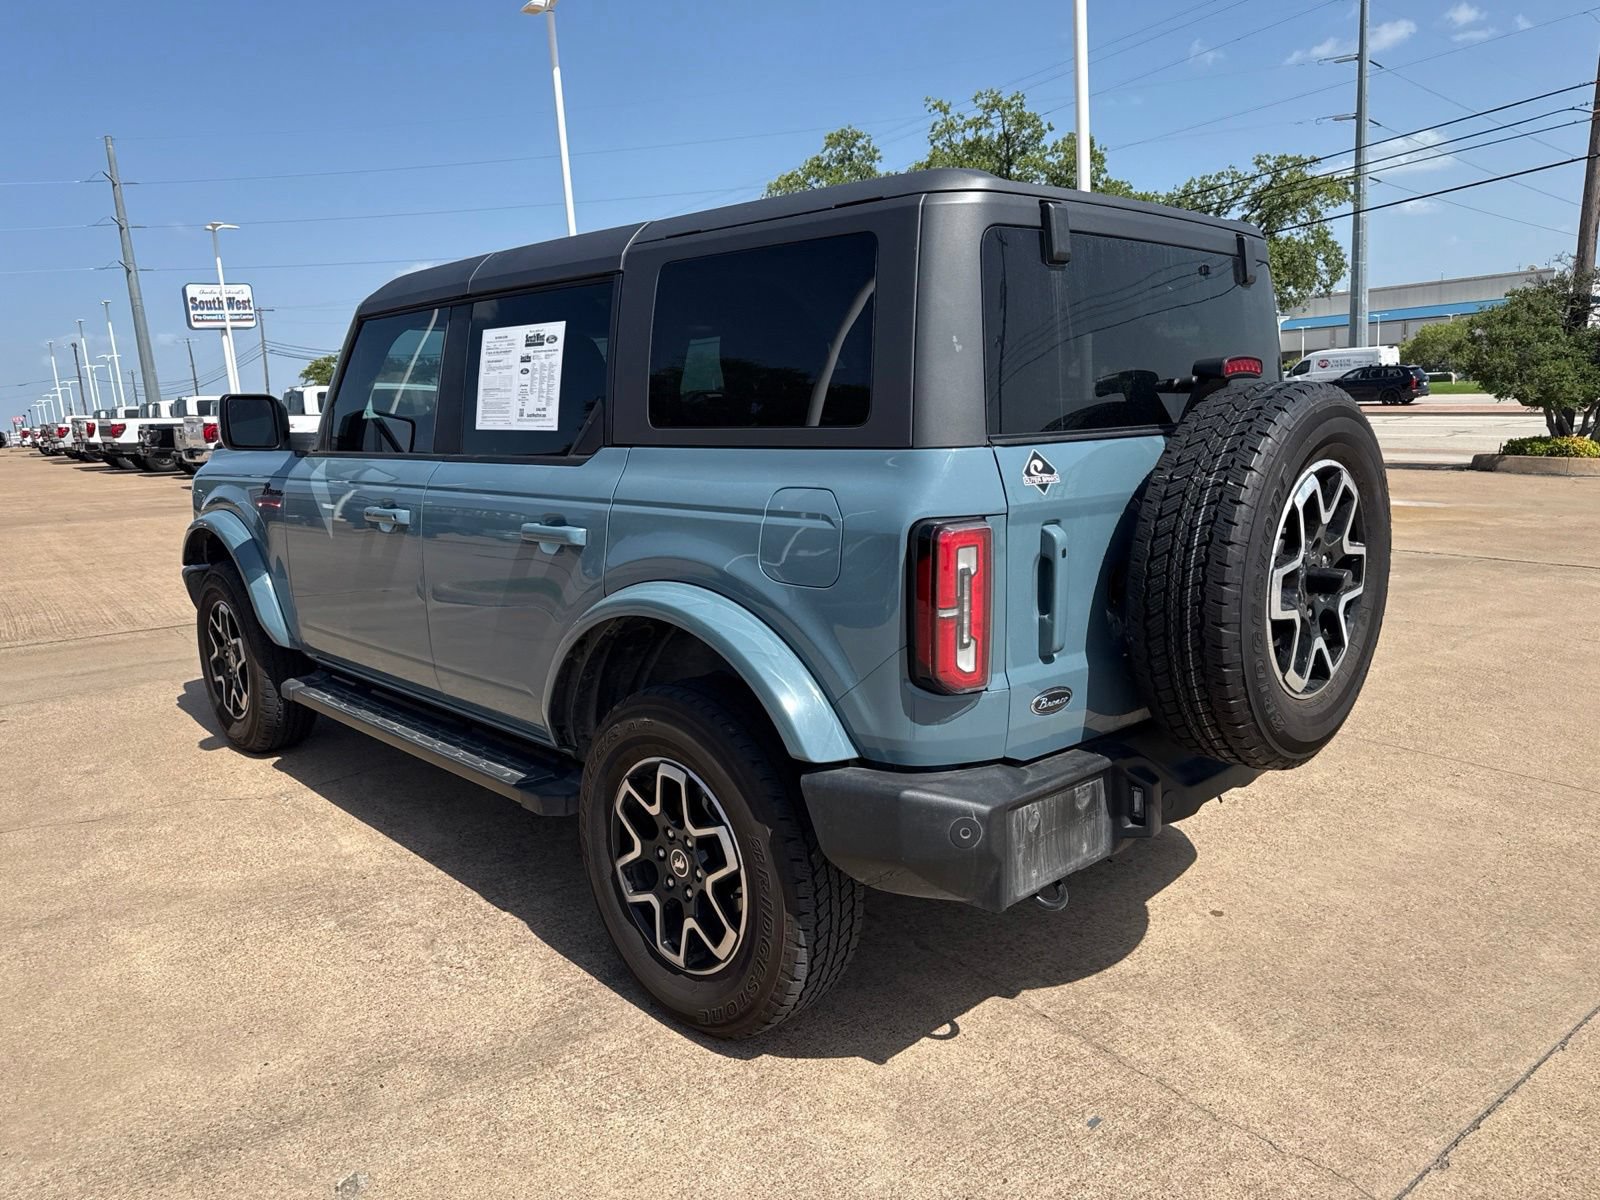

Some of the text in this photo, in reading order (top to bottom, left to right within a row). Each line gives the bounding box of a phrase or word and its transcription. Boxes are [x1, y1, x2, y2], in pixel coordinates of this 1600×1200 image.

[226, 297, 252, 311] West
[1251, 463, 1290, 735] BRIDGESTONE
[1038, 697, 1069, 710] Bronco
[697, 836, 775, 1024] BRIDGESTONE
